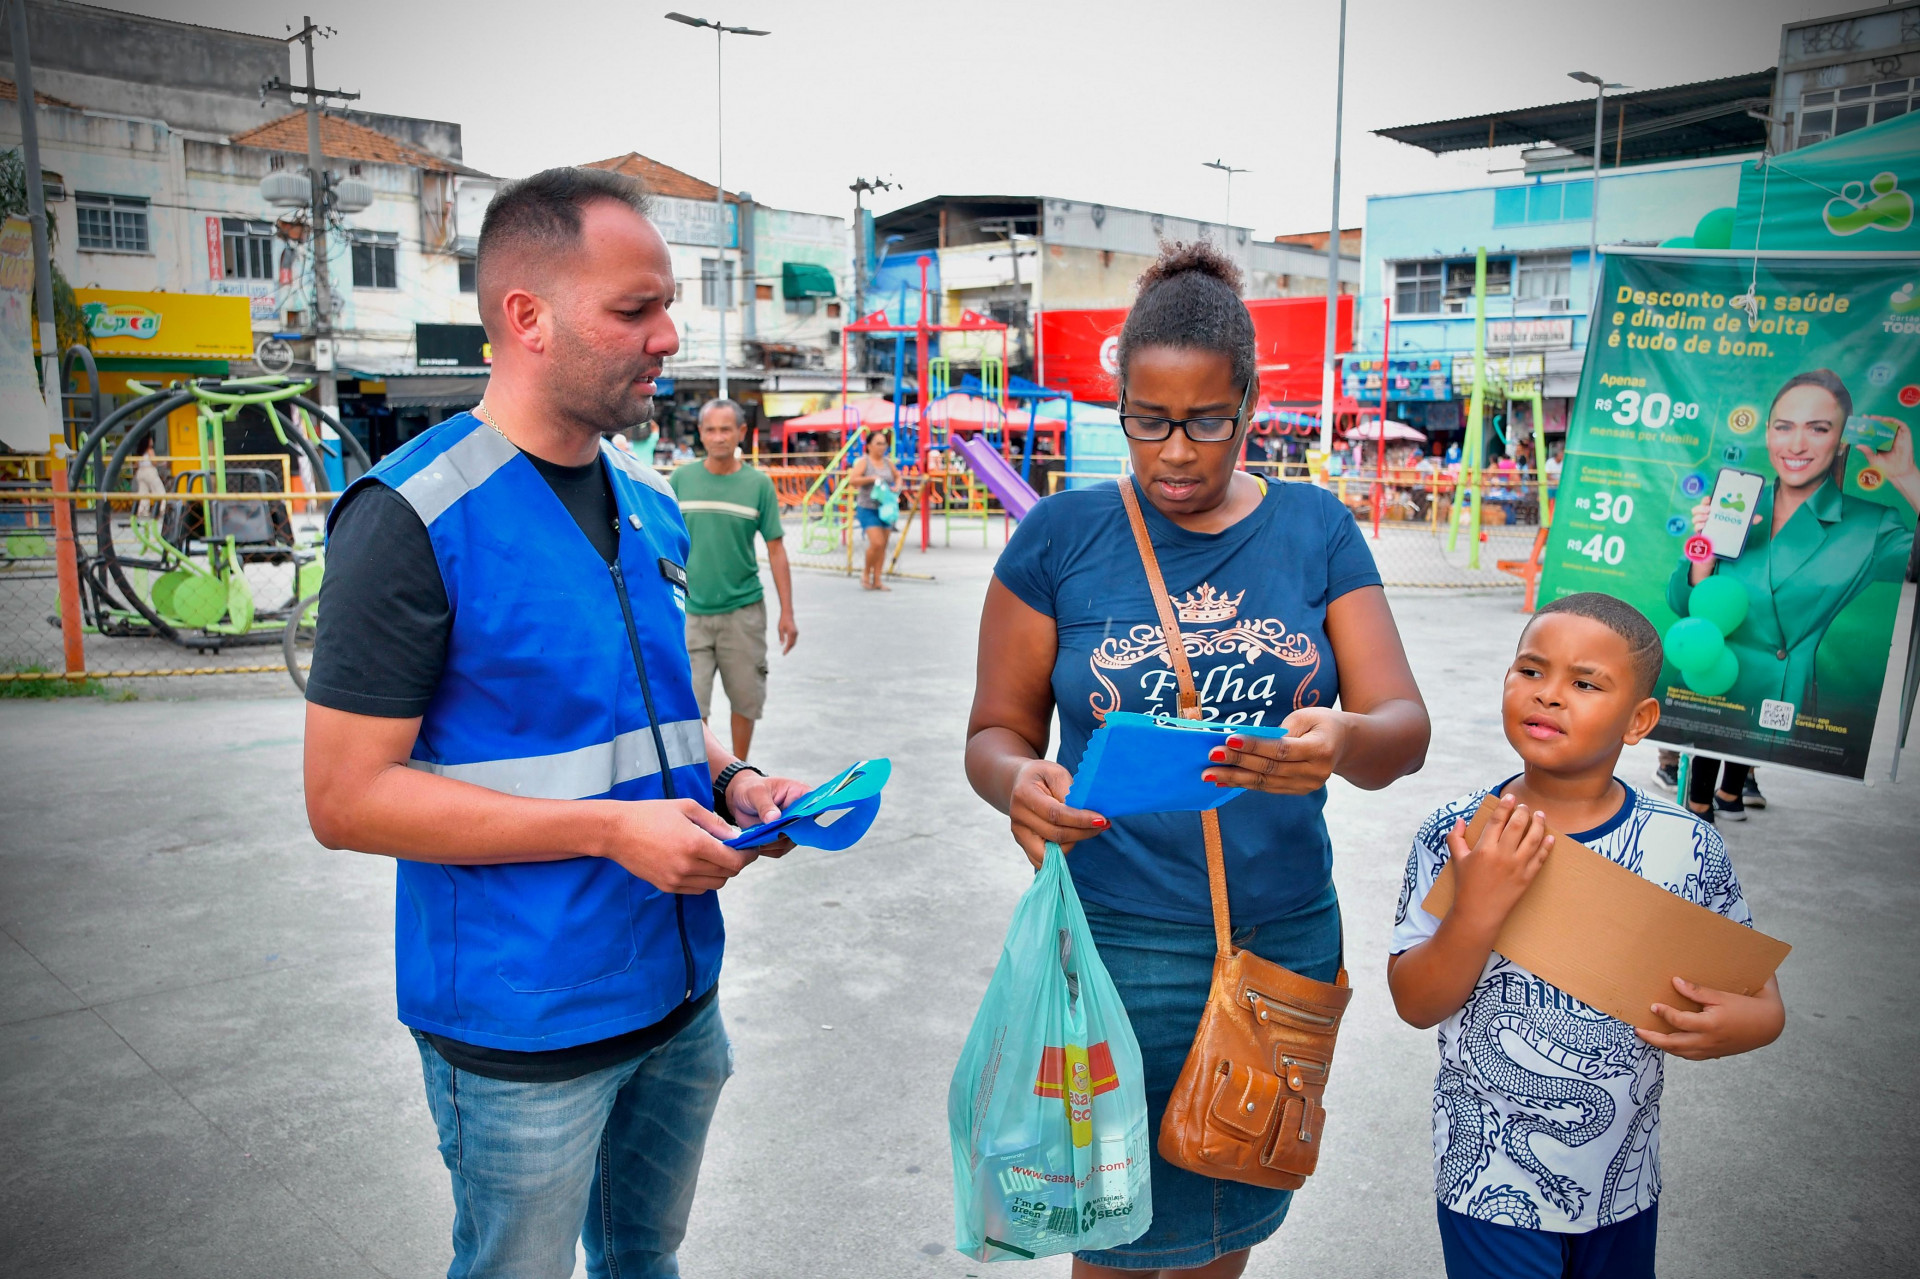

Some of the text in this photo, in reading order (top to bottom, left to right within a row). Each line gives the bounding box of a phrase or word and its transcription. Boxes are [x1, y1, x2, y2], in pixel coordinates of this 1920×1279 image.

[1616, 286, 1725, 309] Desconto
[1773, 293, 1850, 313] saúde
[1612, 309, 1810, 336] e dindim de volta
[1607, 329, 1775, 357] é tudo de bom.
[1600, 373, 1646, 387] Apenas
[1594, 398, 1613, 412] R$
[1590, 426, 1636, 438] mensais
[1638, 432, 1657, 442] por
[1575, 492, 1634, 524] R$ 30
[1714, 512, 1743, 525] TODOS
[1567, 533, 1626, 566] R$ 40
[1519, 1019, 1558, 1044] FLY
[1011, 1205, 1041, 1218] green
[1014, 1197, 1032, 1208] I'm
